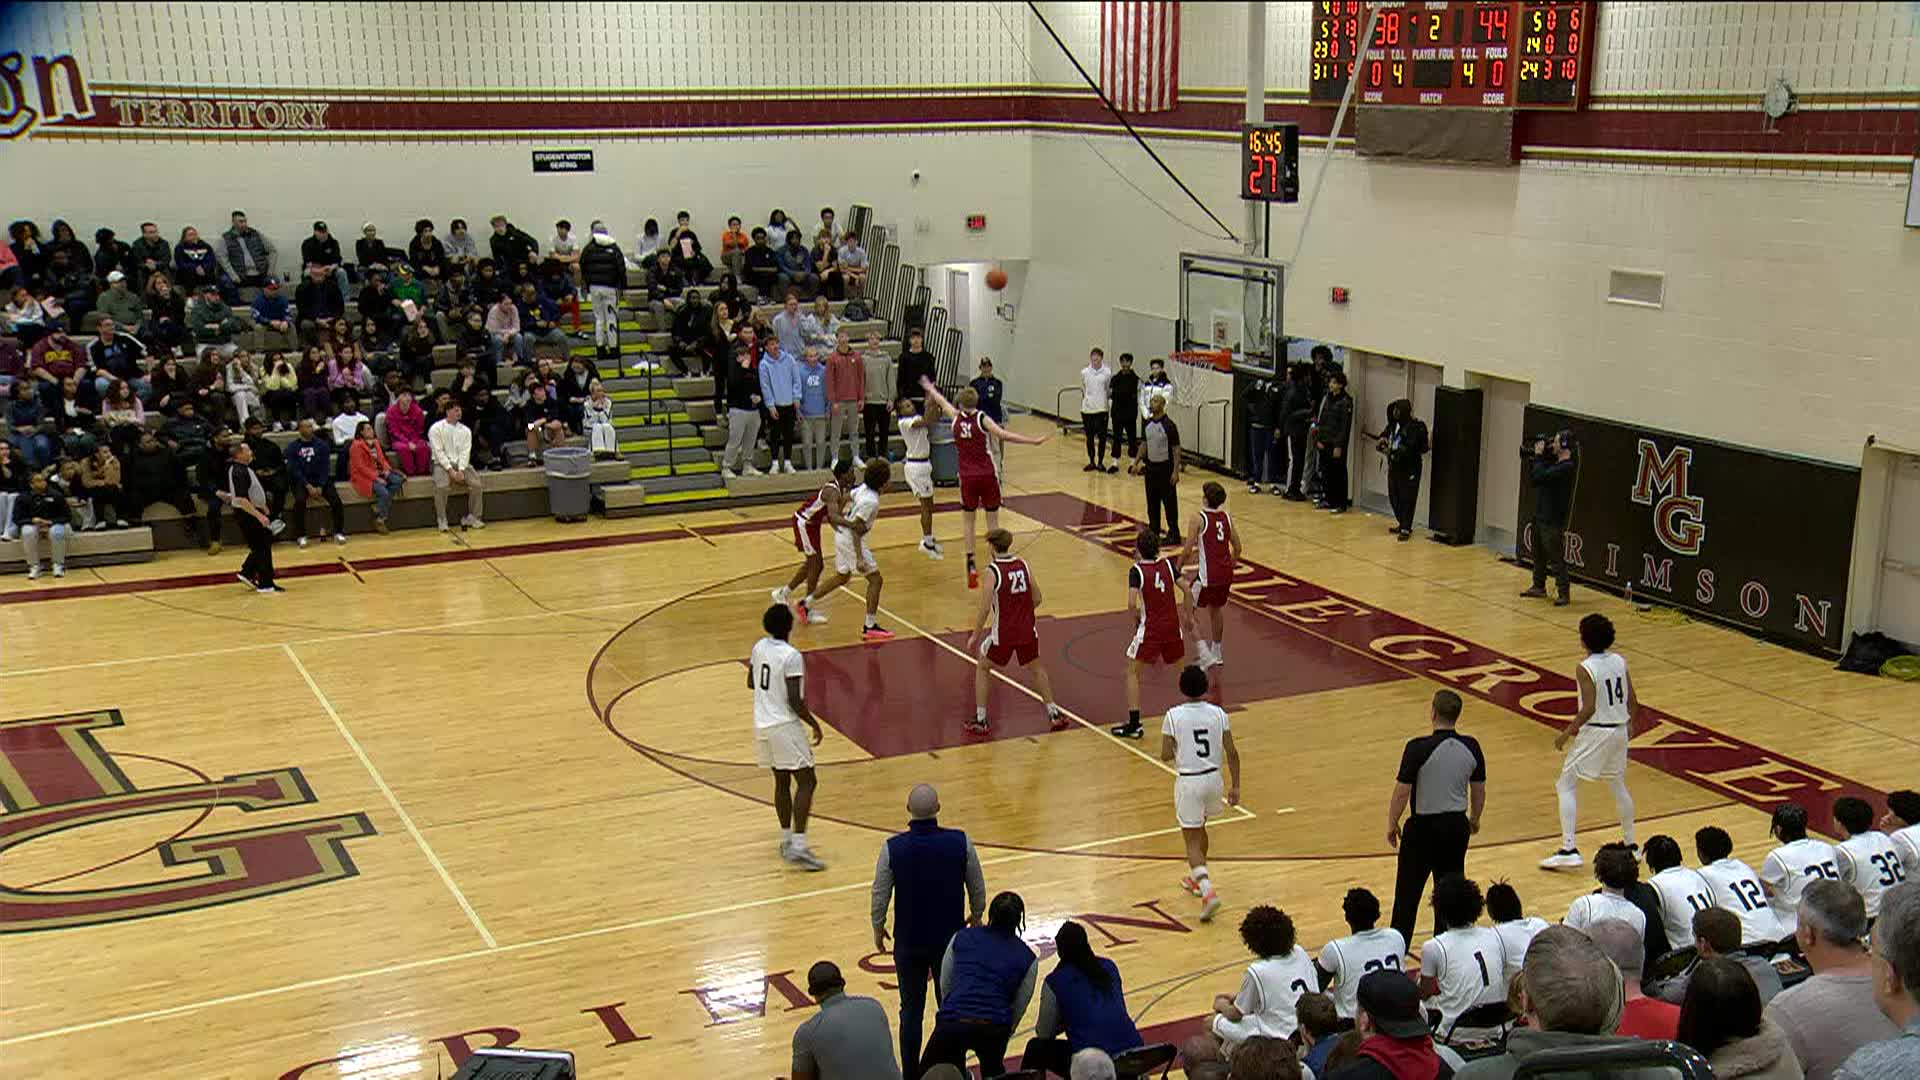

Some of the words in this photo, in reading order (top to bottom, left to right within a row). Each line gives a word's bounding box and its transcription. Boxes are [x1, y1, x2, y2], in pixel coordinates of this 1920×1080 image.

[1321, 21, 1329, 38] 5
[1332, 20, 1339, 38] 2
[1346, 20, 1356, 38] 13
[1375, 13, 1399, 45] 38
[1430, 15, 1440, 40] 2
[1480, 10, 1507, 40] 44
[1533, 11, 1541, 32] 5
[1547, 10, 1556, 31] 0
[1570, 9, 1579, 30] 6
[1314, 41, 1328, 58] 23
[1331, 41, 1338, 58] 0
[1350, 40, 1355, 56] 7
[1412, 49, 1435, 60] PLAYER
[1438, 48, 1454, 60] FOUL
[1485, 47, 1508, 59] FOULS
[1526, 37, 1540, 53] 14
[1545, 34, 1554, 54] 0
[1568, 33, 1578, 54] 0
[1314, 63, 1327, 80] 31
[1371, 62, 1381, 86] 0
[1393, 64, 1402, 85] 4
[1463, 63, 1473, 85] 4
[1492, 61, 1503, 86] 0
[1520, 60, 1538, 80] 24
[1544, 59, 1552, 80] 3
[1562, 59, 1576, 80] 10
[1482, 93, 1504, 104] SCORE
[111, 97, 329, 129] TERRITORY
[1249, 131, 1282, 154] 16:45
[1249, 154, 1277, 193] 27
[1216, 521, 1224, 541] 3
[1008, 569, 1027, 592] 23
[1155, 572, 1165, 592] 4
[760, 663, 770, 690] 0
[1605, 677, 1624, 706] 14
[1193, 729, 1210, 758] 5
[1870, 851, 1906, 886] 32
[1728, 879, 1768, 911] 12
[1474, 951, 1489, 987] 1
